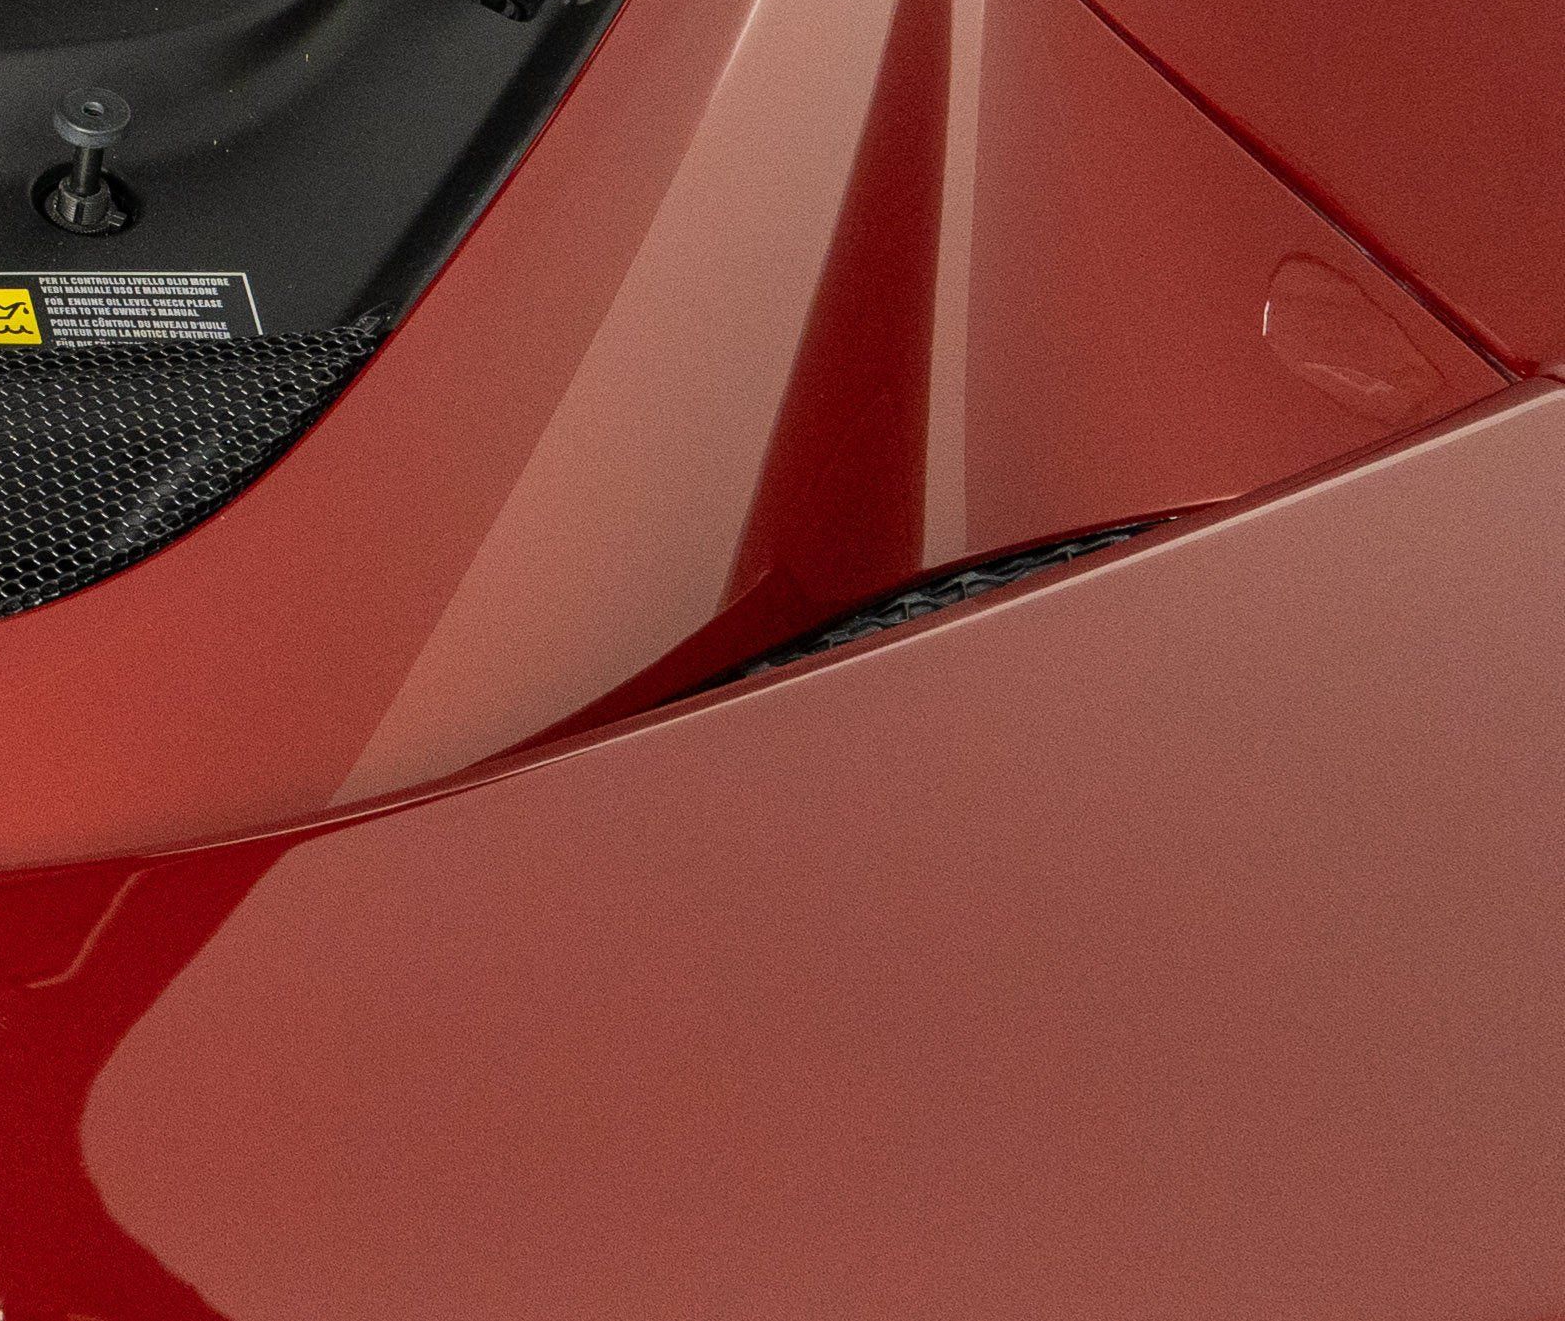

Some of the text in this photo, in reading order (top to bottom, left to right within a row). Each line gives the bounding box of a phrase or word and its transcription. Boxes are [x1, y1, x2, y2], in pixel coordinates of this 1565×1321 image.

[128, 278, 164, 286] LIVELLO
[167, 278, 187, 286] OLIO
[41, 286, 62, 294] VEDI
[135, 287, 141, 295] E
[143, 287, 218, 295] MANUTENZIONE
[69, 298, 104, 306] ENGINE
[153, 299, 185, 307] CHECK
[187, 300, 223, 308] PLEASE
[47, 307, 199, 317] REFER TO THE OWNER'S MANUAL
[51, 319, 77, 327] POUR
[138, 320, 151, 328] DU
[153, 320, 188, 329] NIVEAU
[190, 321, 227, 330] D'HUILE
[53, 329, 231, 340] MOTEUR VOIR LA NOTICE D'ENTRETIEN
